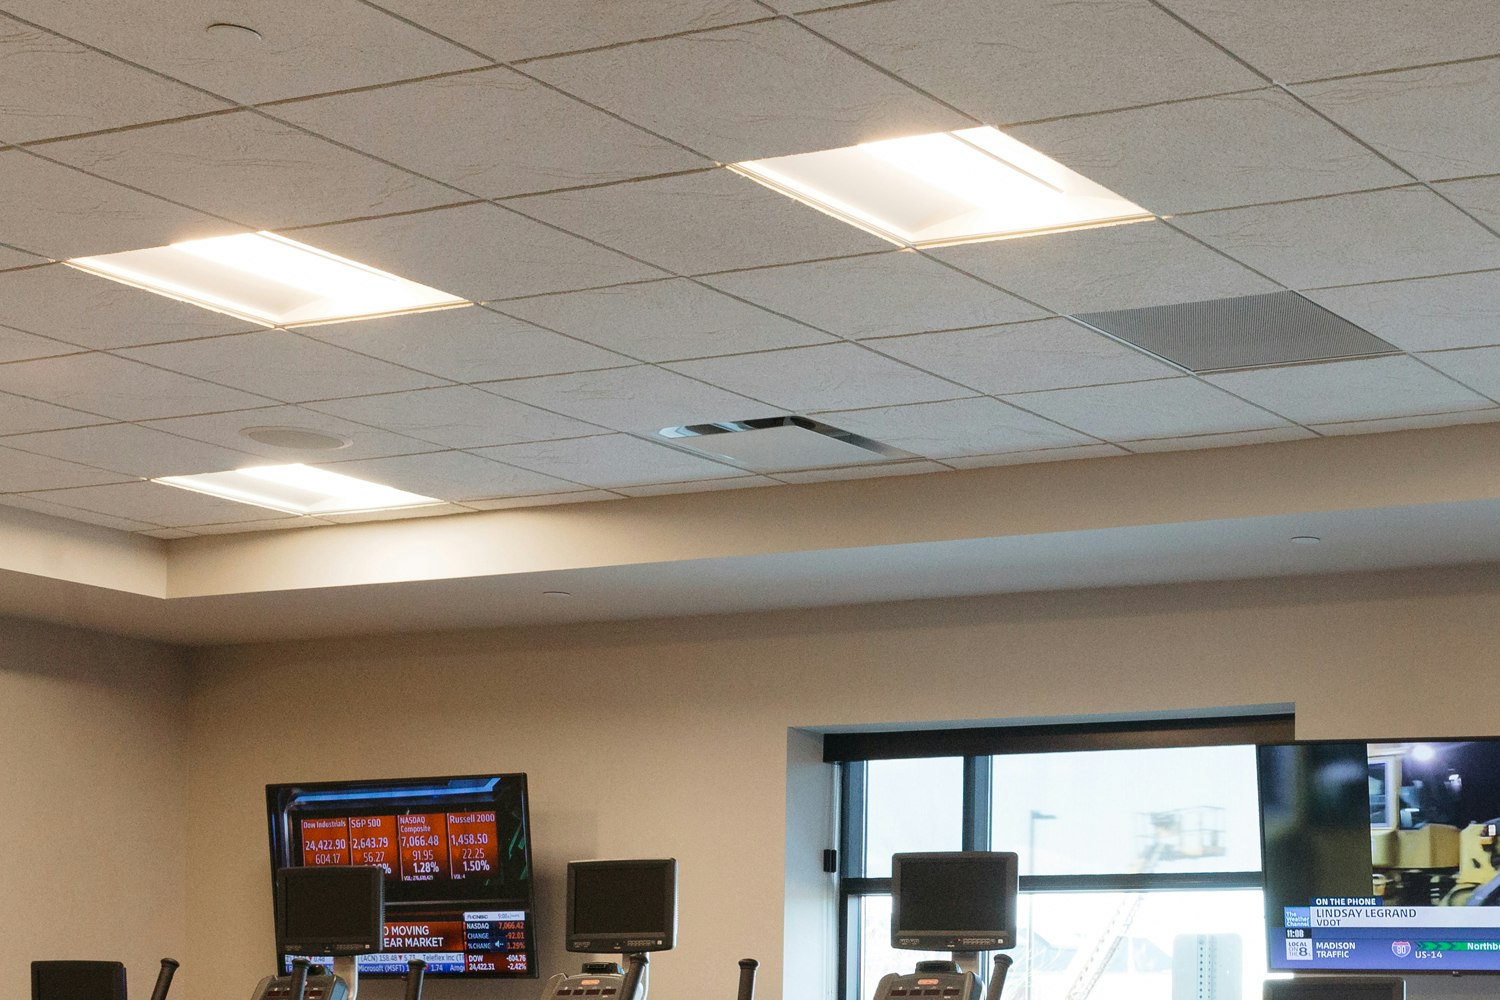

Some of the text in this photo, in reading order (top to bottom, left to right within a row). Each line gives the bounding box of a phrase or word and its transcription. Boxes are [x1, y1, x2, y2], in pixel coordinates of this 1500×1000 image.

[351, 818, 382, 829] S&P 500
[400, 816, 426, 825] NASDAQ
[449, 813, 496, 824] Russell 2000
[303, 819, 347, 829] Dow Industrials
[400, 824, 431, 834] Composite
[305, 838, 346, 852] 24,422.90
[352, 836, 389, 850] 2,643.79
[401, 834, 439, 848] 7,066.48
[450, 833, 489, 847] 1,458.50
[315, 852, 341, 865] 604.17
[363, 851, 385, 863] 56.27
[412, 849, 434, 861] 91.95
[462, 847, 485, 860] 22.25
[412, 861, 440, 873] 1.28%
[463, 859, 490, 872] 1.50%
[1315, 897, 1377, 906] ON THE PHONE
[1316, 908, 1417, 918] LINDSAY LEGRAND
[466, 922, 490, 930] NASDAQ
[1316, 919, 1341, 927] VDOT
[391, 925, 430, 936] MOVING
[467, 932, 490, 940] CHANGE
[383, 937, 444, 948] EAR MARKET
[1316, 942, 1356, 950] MADISON
[1316, 950, 1349, 958] TRAFFIC
[1396, 946, 1406, 955] 90
[1414, 950, 1443, 959] US-14
[360, 954, 378, 962] (ACN)
[422, 953, 445, 961] Teleflex
[445, 953, 455, 961] Inc
[468, 954, 484, 962] DOW
[358, 964, 385, 972] Microsoft
[385, 964, 405, 973] (MSFT)
[468, 962, 496, 972] 24,422.31
